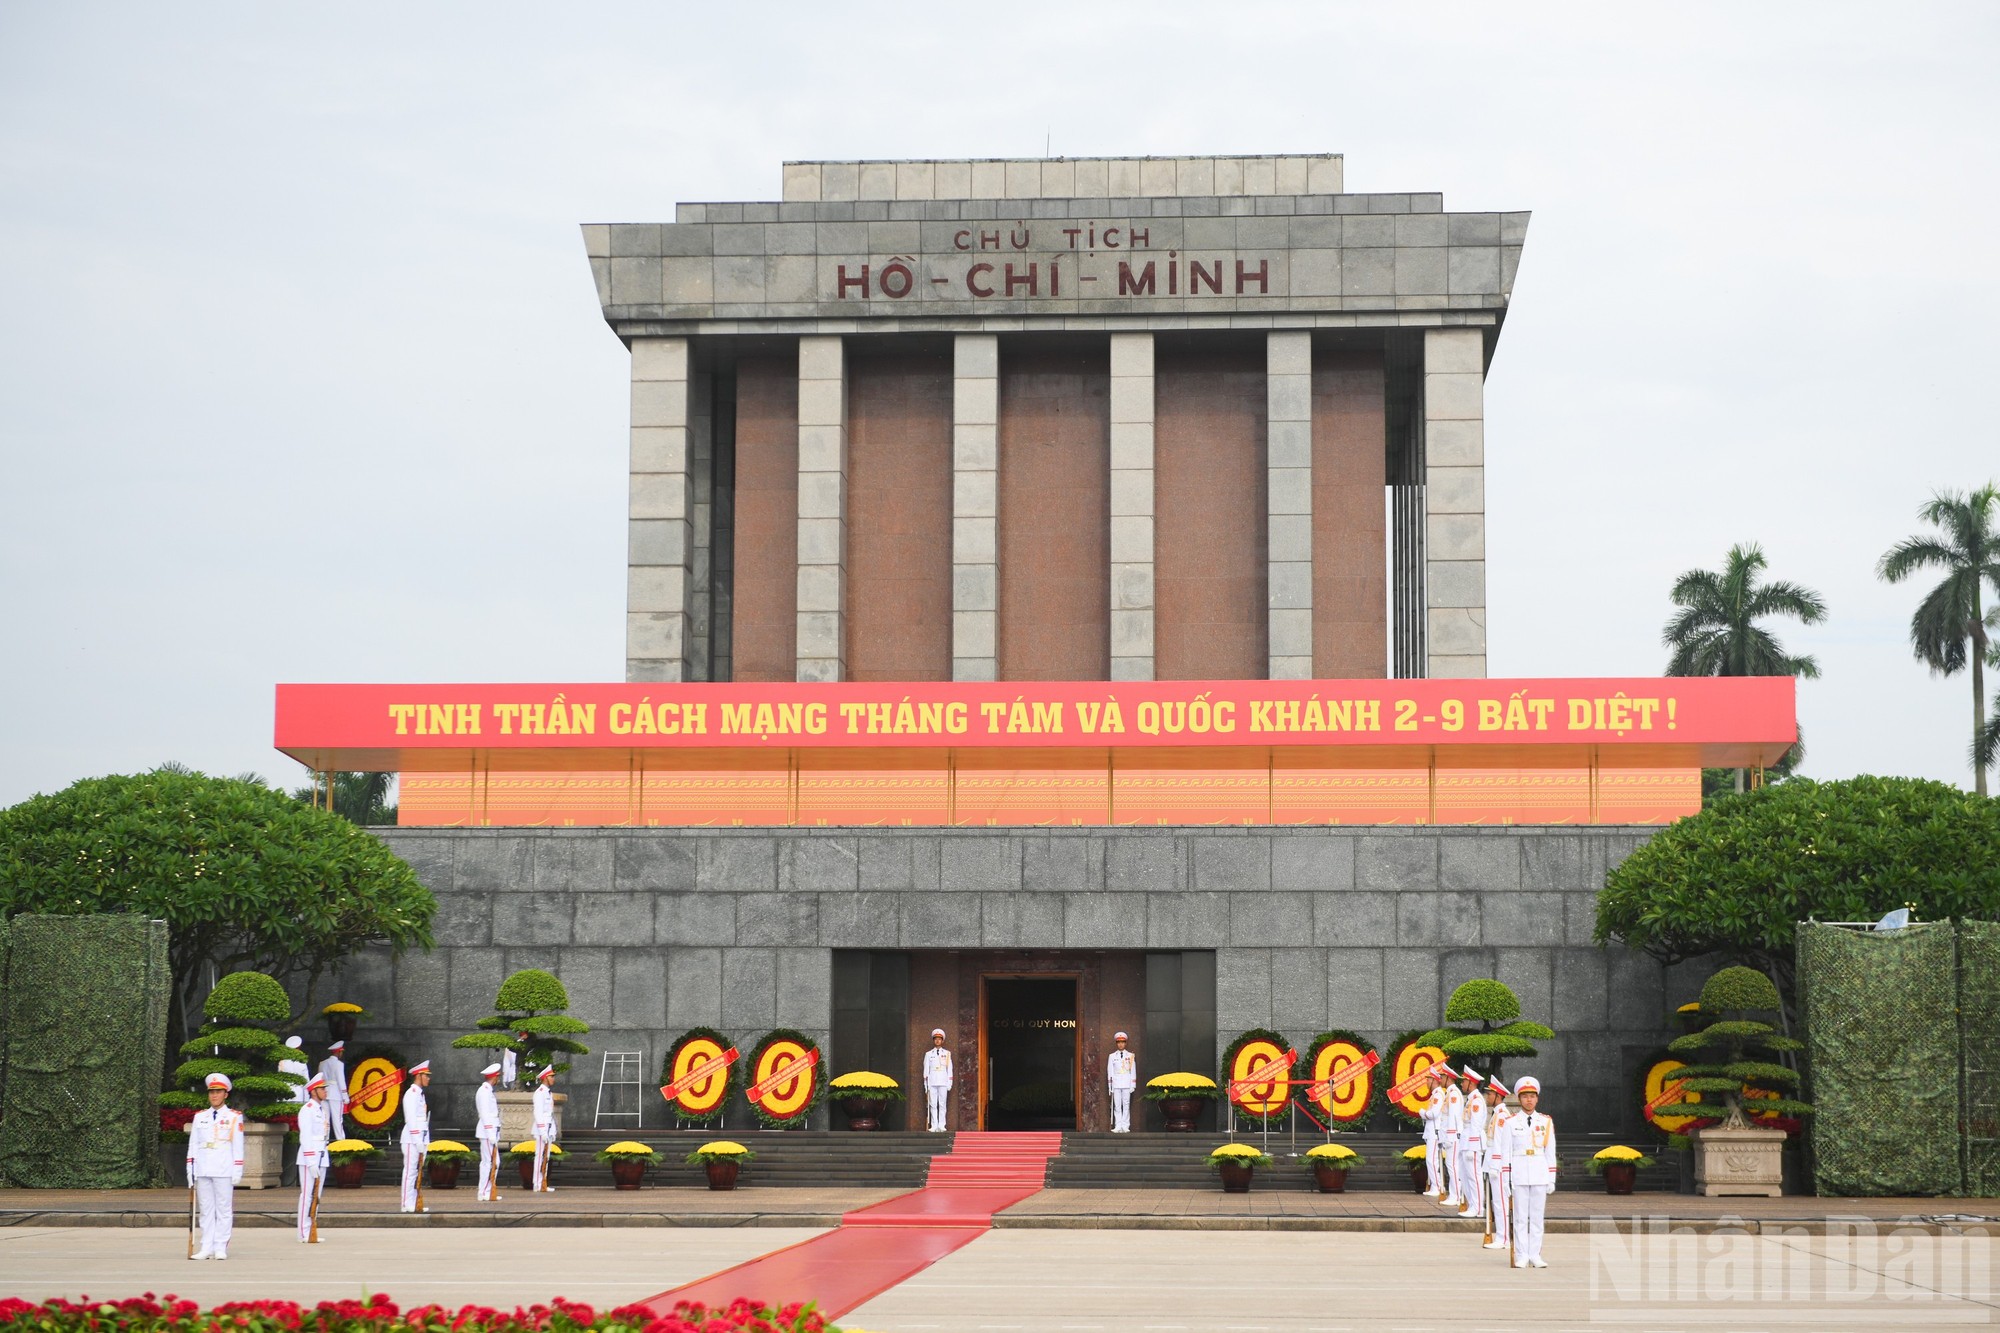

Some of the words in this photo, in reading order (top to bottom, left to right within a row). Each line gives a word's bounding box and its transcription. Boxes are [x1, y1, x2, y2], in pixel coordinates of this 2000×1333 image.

[954, 221, 1030, 250] CHỦ
[837, 255, 916, 299] HỒ
[966, 253, 1065, 297] CHÍ
[388, 703, 482, 735] TINH
[493, 692, 597, 735] THẦN
[609, 696, 708, 735] CÁCH
[719, 702, 828, 741] MẠNG
[840, 696, 968, 735] THÁNG
[981, 695, 1064, 734] TÁM
[1076, 694, 1126, 734] VÀ
[1137, 691, 1236, 736] QUỐC
[1249, 693, 1382, 733] KHÁNH
[1394, 699, 1465, 732] 2-9
[1478, 689, 1556, 732] BẤT
